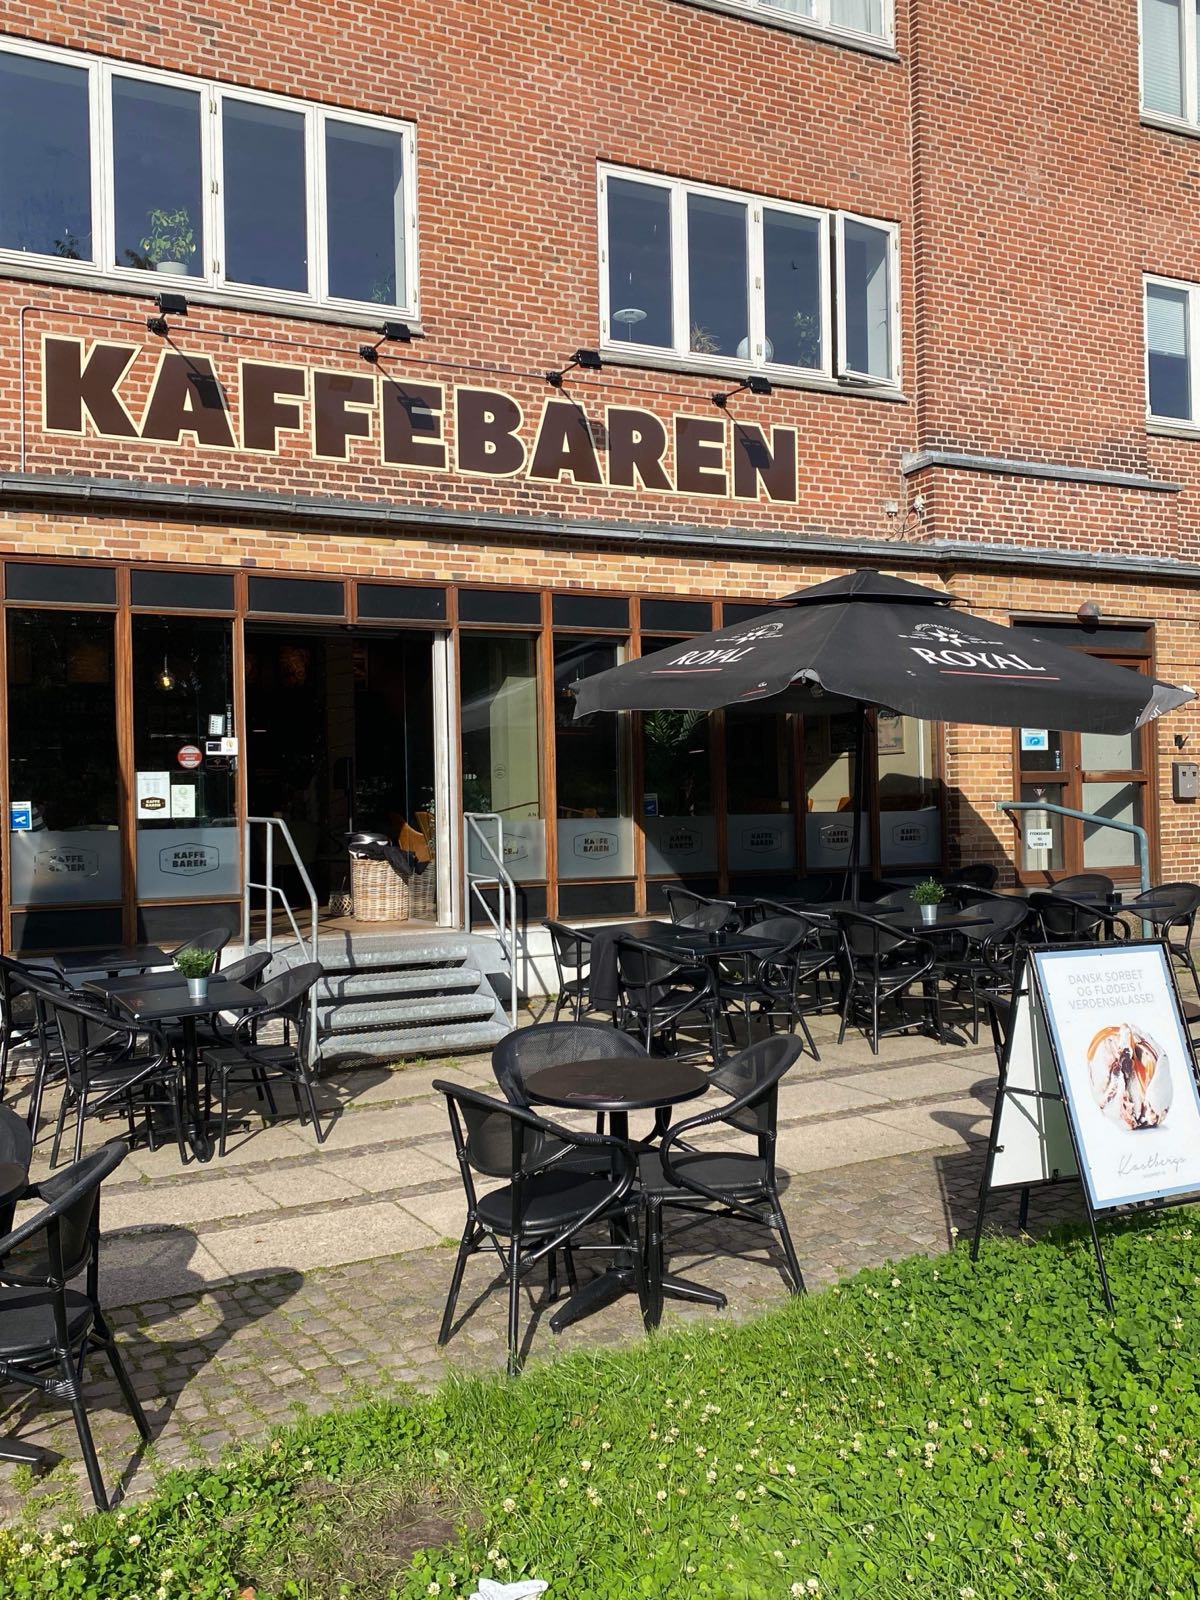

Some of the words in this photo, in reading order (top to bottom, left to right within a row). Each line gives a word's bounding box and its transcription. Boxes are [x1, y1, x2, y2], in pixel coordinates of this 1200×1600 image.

[41, 333, 800, 506] KAFFEBAREN
[666, 646, 757, 666] ROYAL
[909, 646, 1047, 672] ROYAL
[174, 851, 206, 859] KAFFE
[172, 859, 207, 868] BAREN
[1068, 972, 1103, 985] DANSK
[1104, 969, 1144, 982] SORBET
[1076, 986, 1092, 997] OG
[1094, 982, 1136, 995] FLØDEIS
